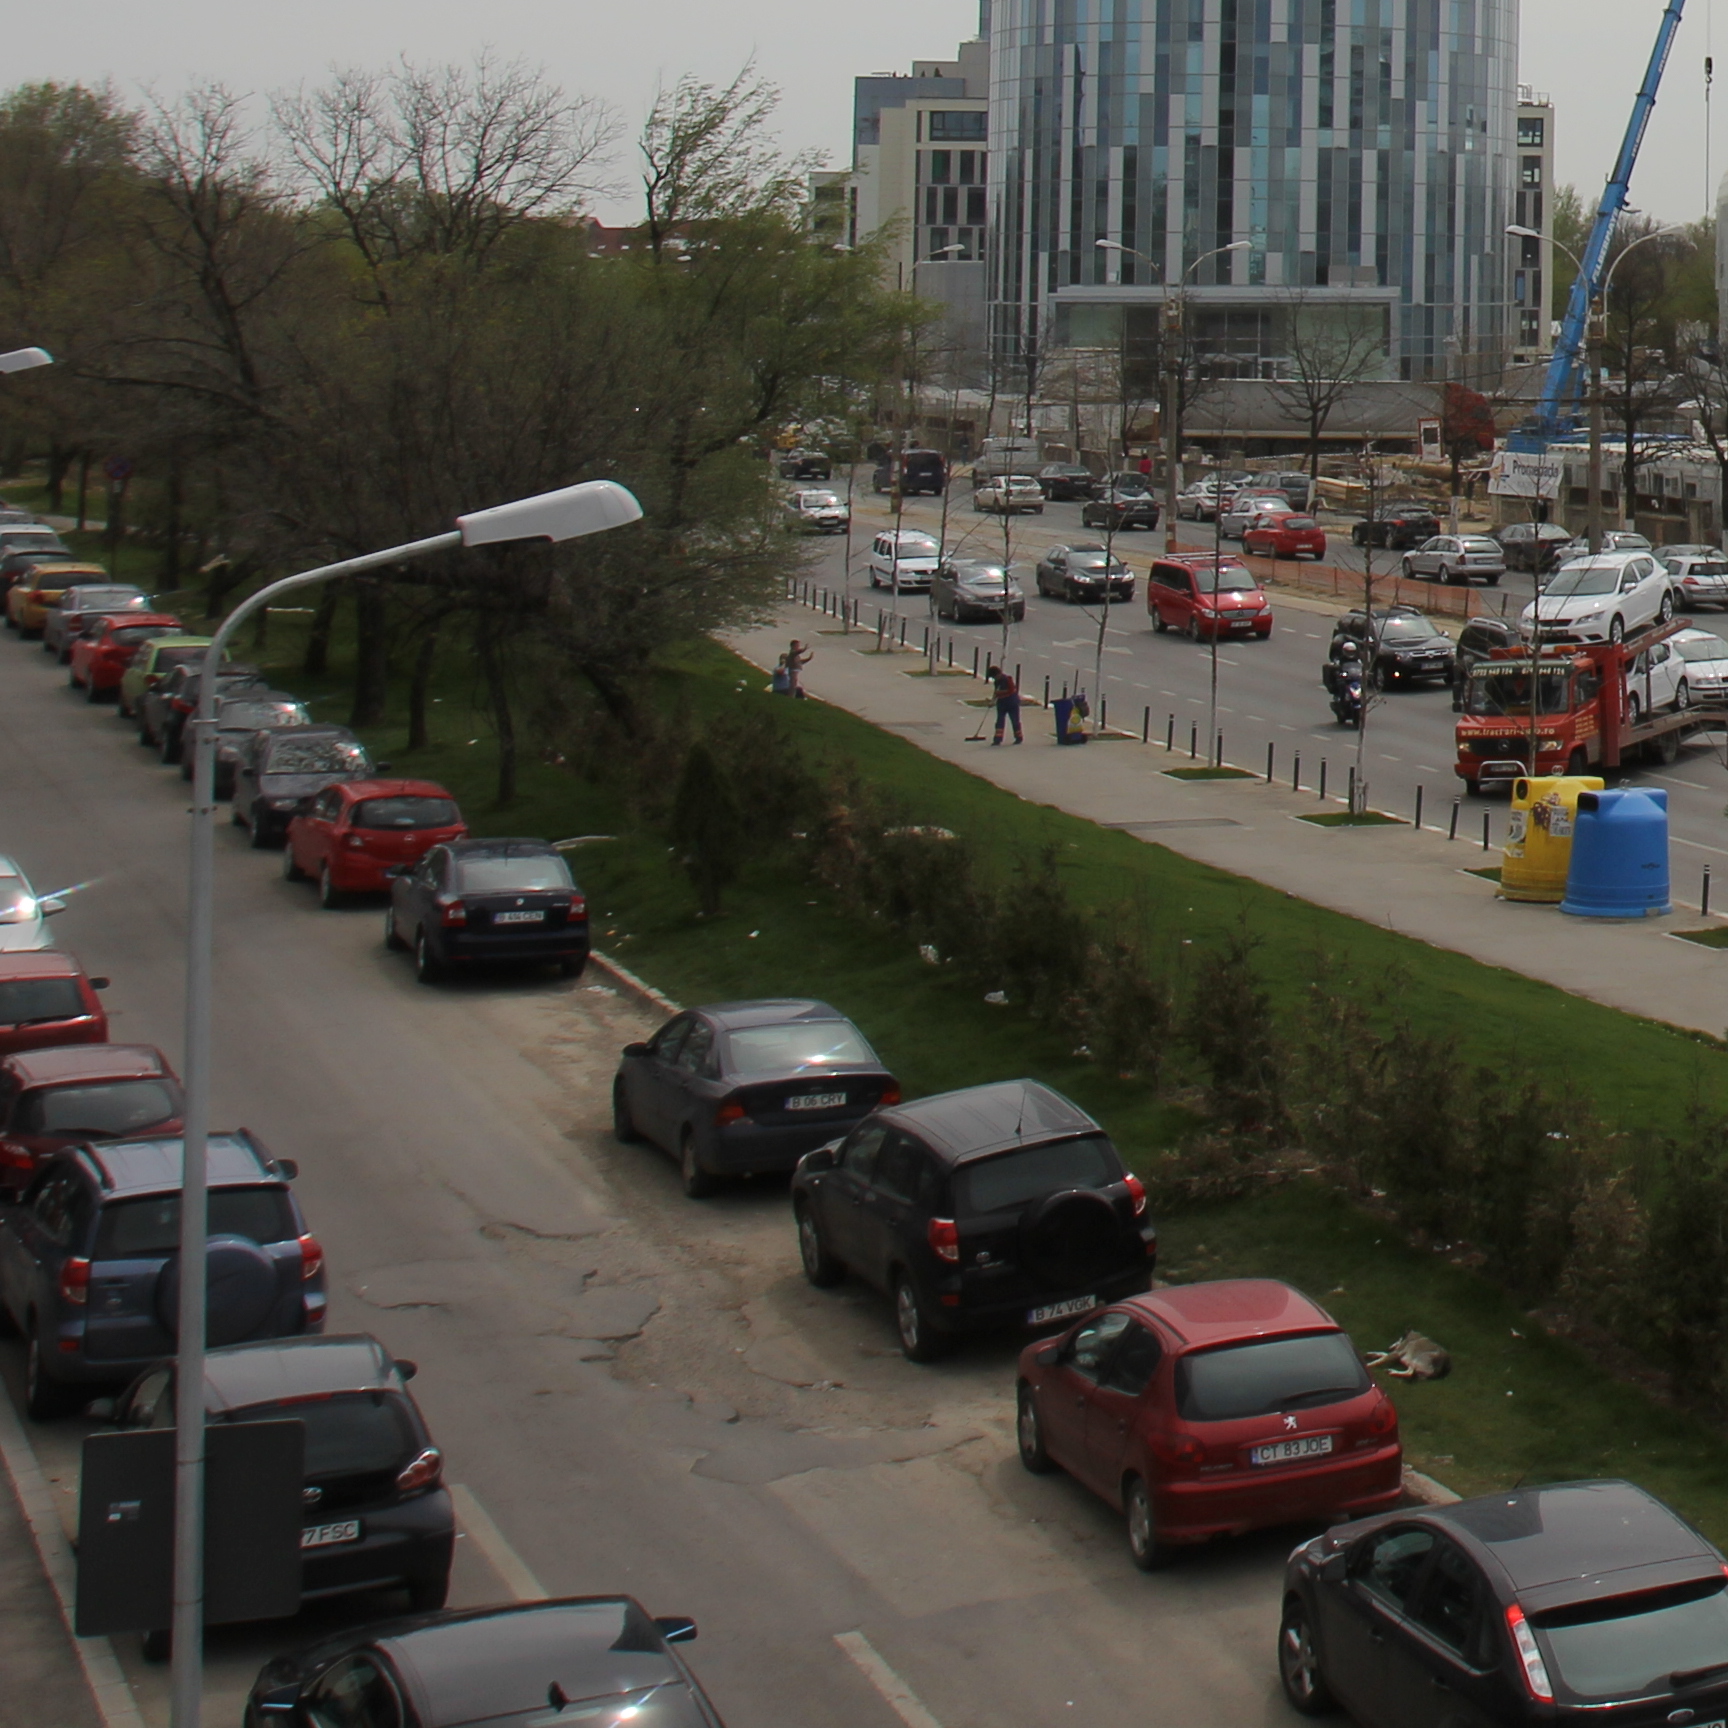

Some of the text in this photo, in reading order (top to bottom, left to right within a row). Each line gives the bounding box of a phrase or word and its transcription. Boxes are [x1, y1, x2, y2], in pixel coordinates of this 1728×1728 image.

[793, 1096, 801, 1108] B
[821, 1093, 842, 1106] CRY
[1036, 1309, 1044, 1321] B
[1067, 1297, 1091, 1312] VGK
[1260, 1436, 1329, 1460] CT 83 JOE
[319, 1522, 356, 1541] FSC
